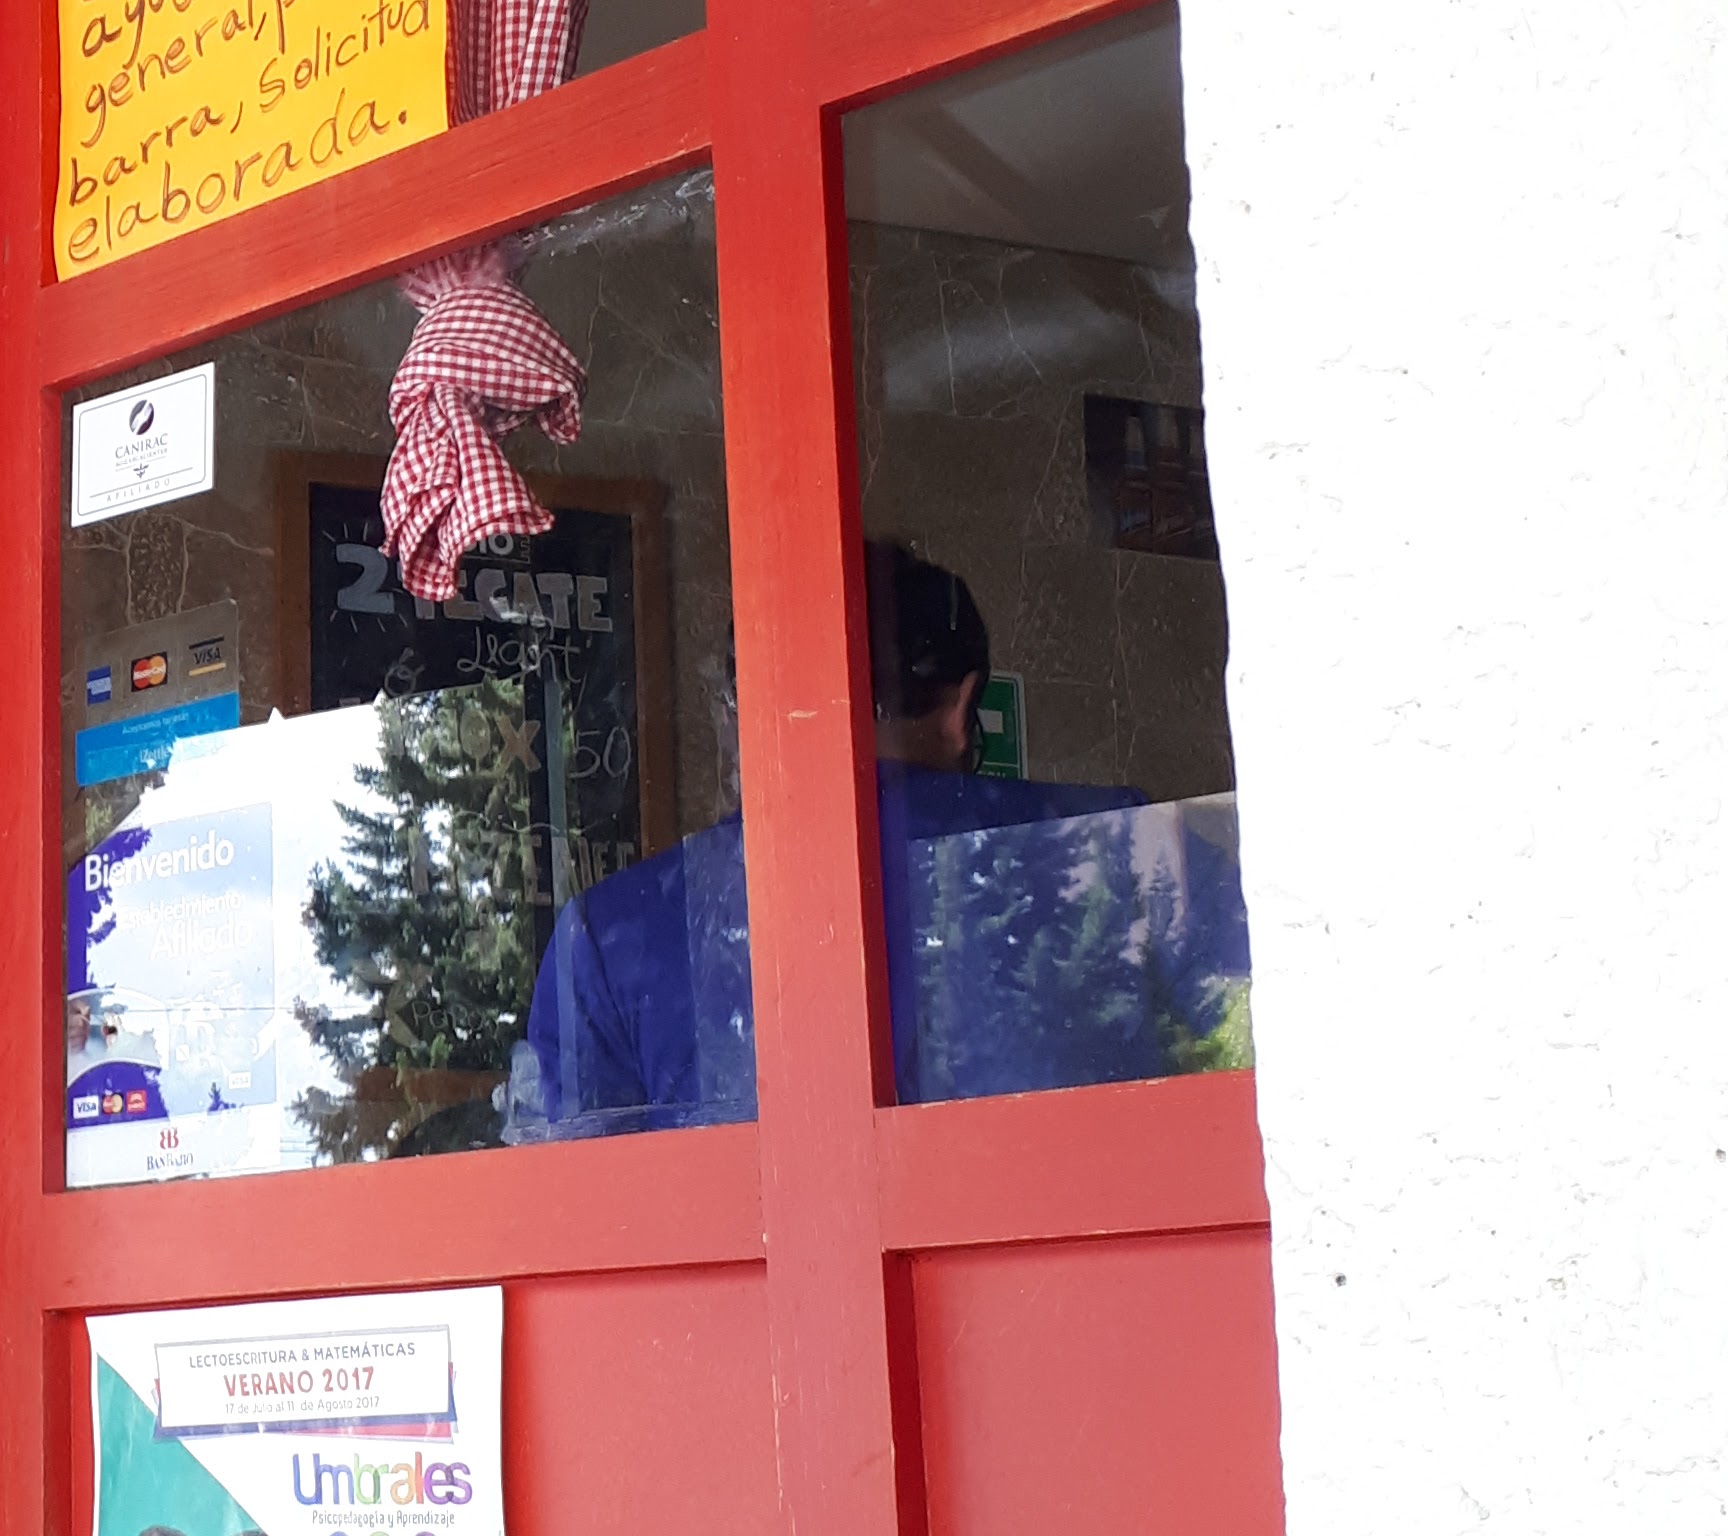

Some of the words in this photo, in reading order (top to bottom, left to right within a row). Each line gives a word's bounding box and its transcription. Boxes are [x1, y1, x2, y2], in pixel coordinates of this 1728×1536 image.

[70, 101, 243, 207] barra,
[67, 89, 408, 264] elaborada.
[115, 433, 168, 459] CANIRAC
[107, 478, 170, 502] AFILIADO
[336, 542, 395, 614] 2
[194, 647, 221, 665] VISA
[569, 726, 632, 779] 50
[84, 830, 235, 892] Bienvenido
[76, 1100, 97, 1114] VISA
[189, 1349, 297, 1369] LECTOESCRITURA
[301, 1348, 310, 1362] &
[314, 1341, 416, 1361] MATEMÁTICAS
[224, 1370, 313, 1397] VERANO
[322, 1366, 374, 1392] 2017
[225, 1403, 234, 1414] 17
[237, 1403, 249, 1414] de
[300, 1399, 314, 1412] de
[318, 1397, 353, 1414] Agosto
[356, 1396, 380, 1410] 2017
[292, 1451, 473, 1506] Umbrales
[387, 1514, 394, 1528] y
[396, 1510, 455, 1528] Aprendizaje
